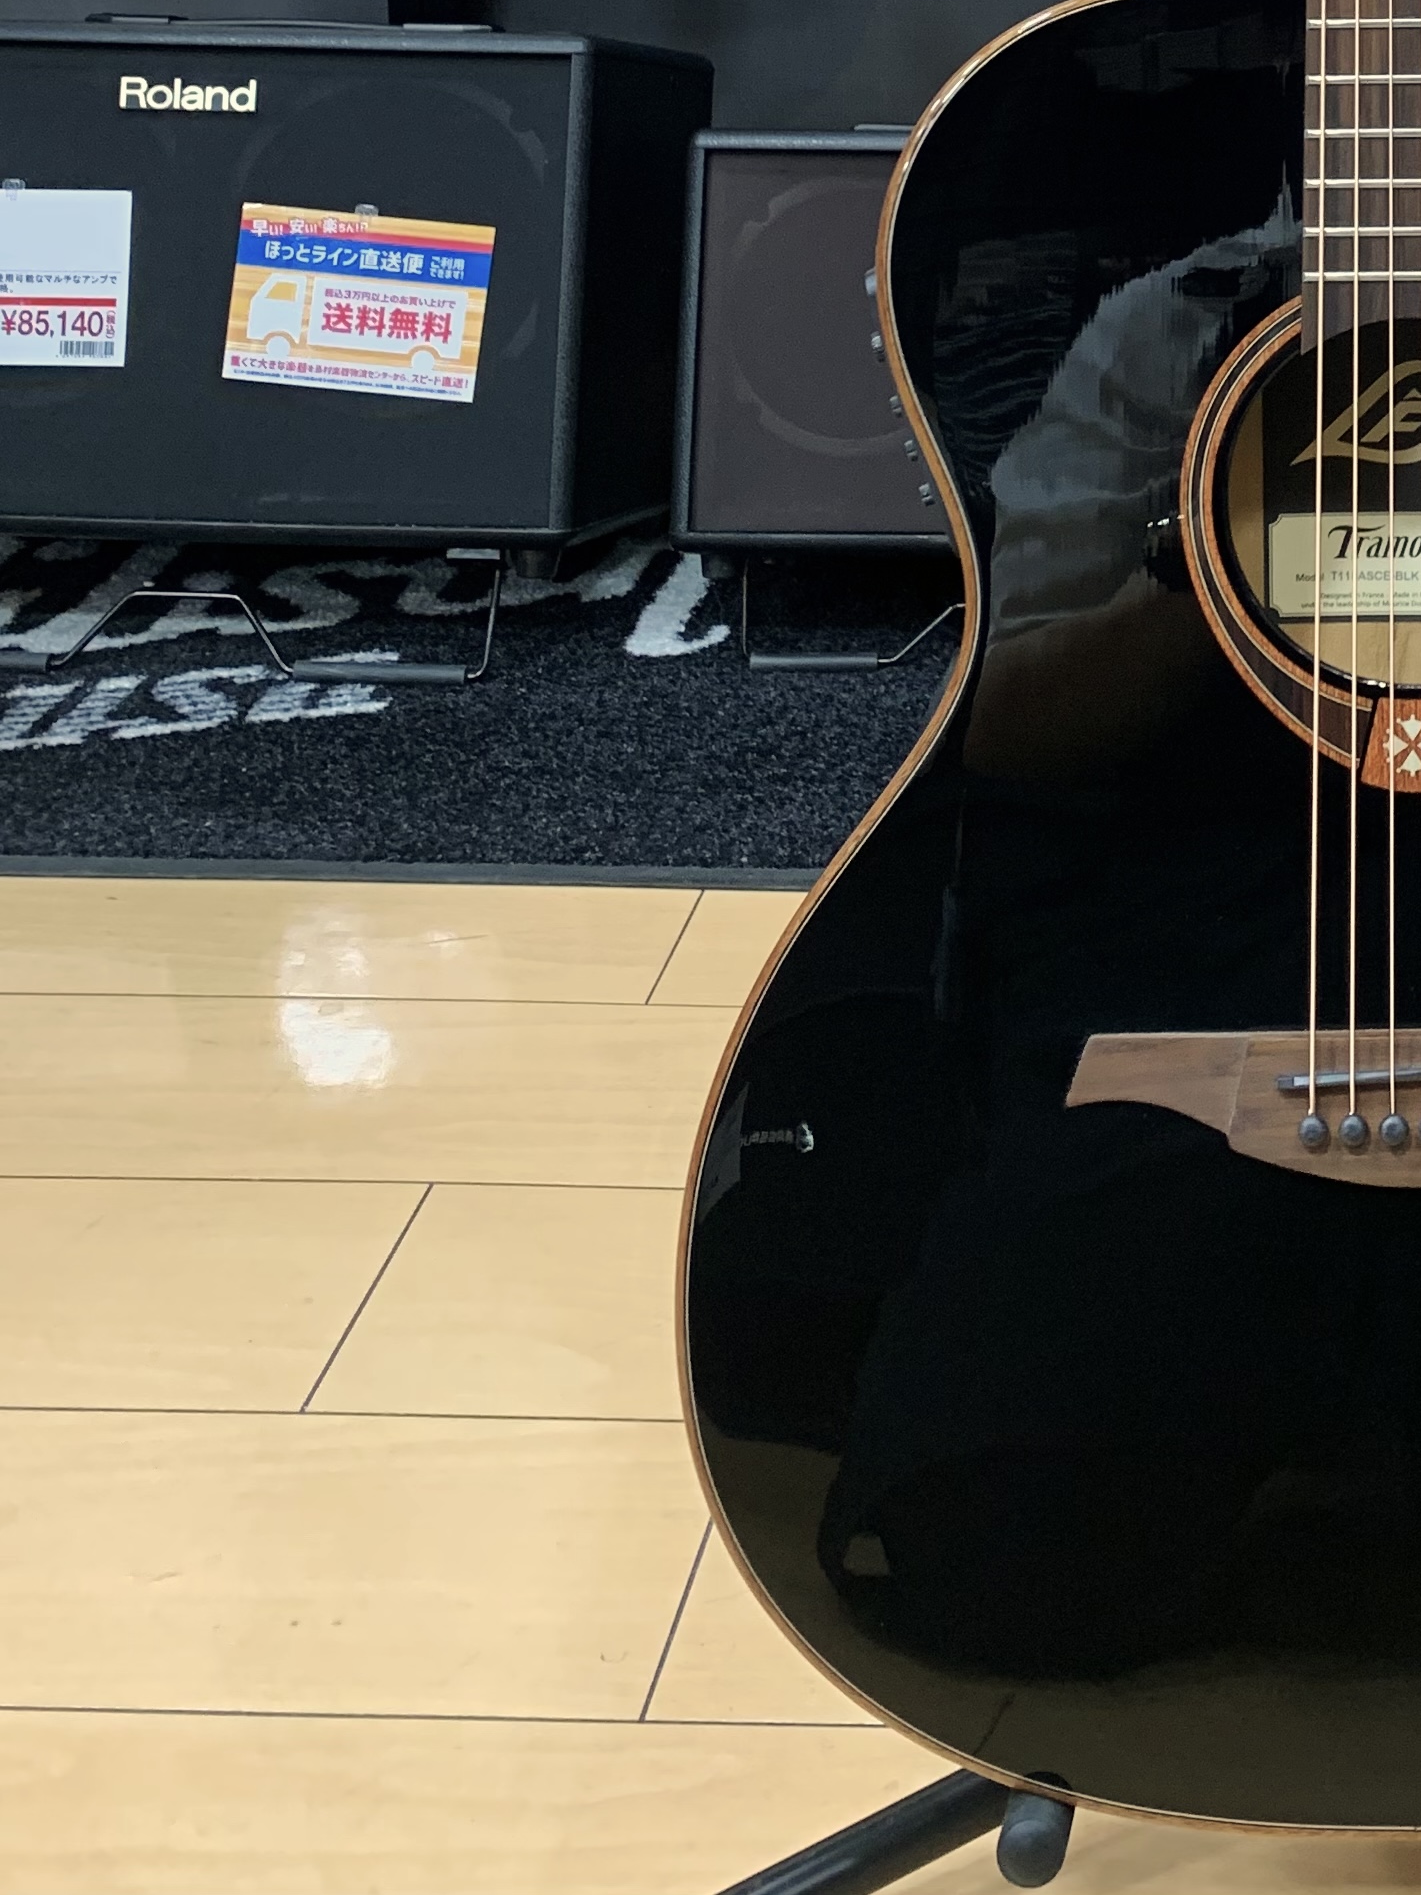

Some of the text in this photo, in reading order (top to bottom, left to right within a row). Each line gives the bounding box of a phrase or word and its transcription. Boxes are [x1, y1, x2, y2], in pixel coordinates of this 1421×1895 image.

[119, 76, 257, 113] Roland
[264, 240, 424, 276] ほっとライン直送便
[1, 309, 104, 338] ¥85,140
[321, 301, 453, 345] 送料無料
[1295, 572, 1324, 582] Modl
